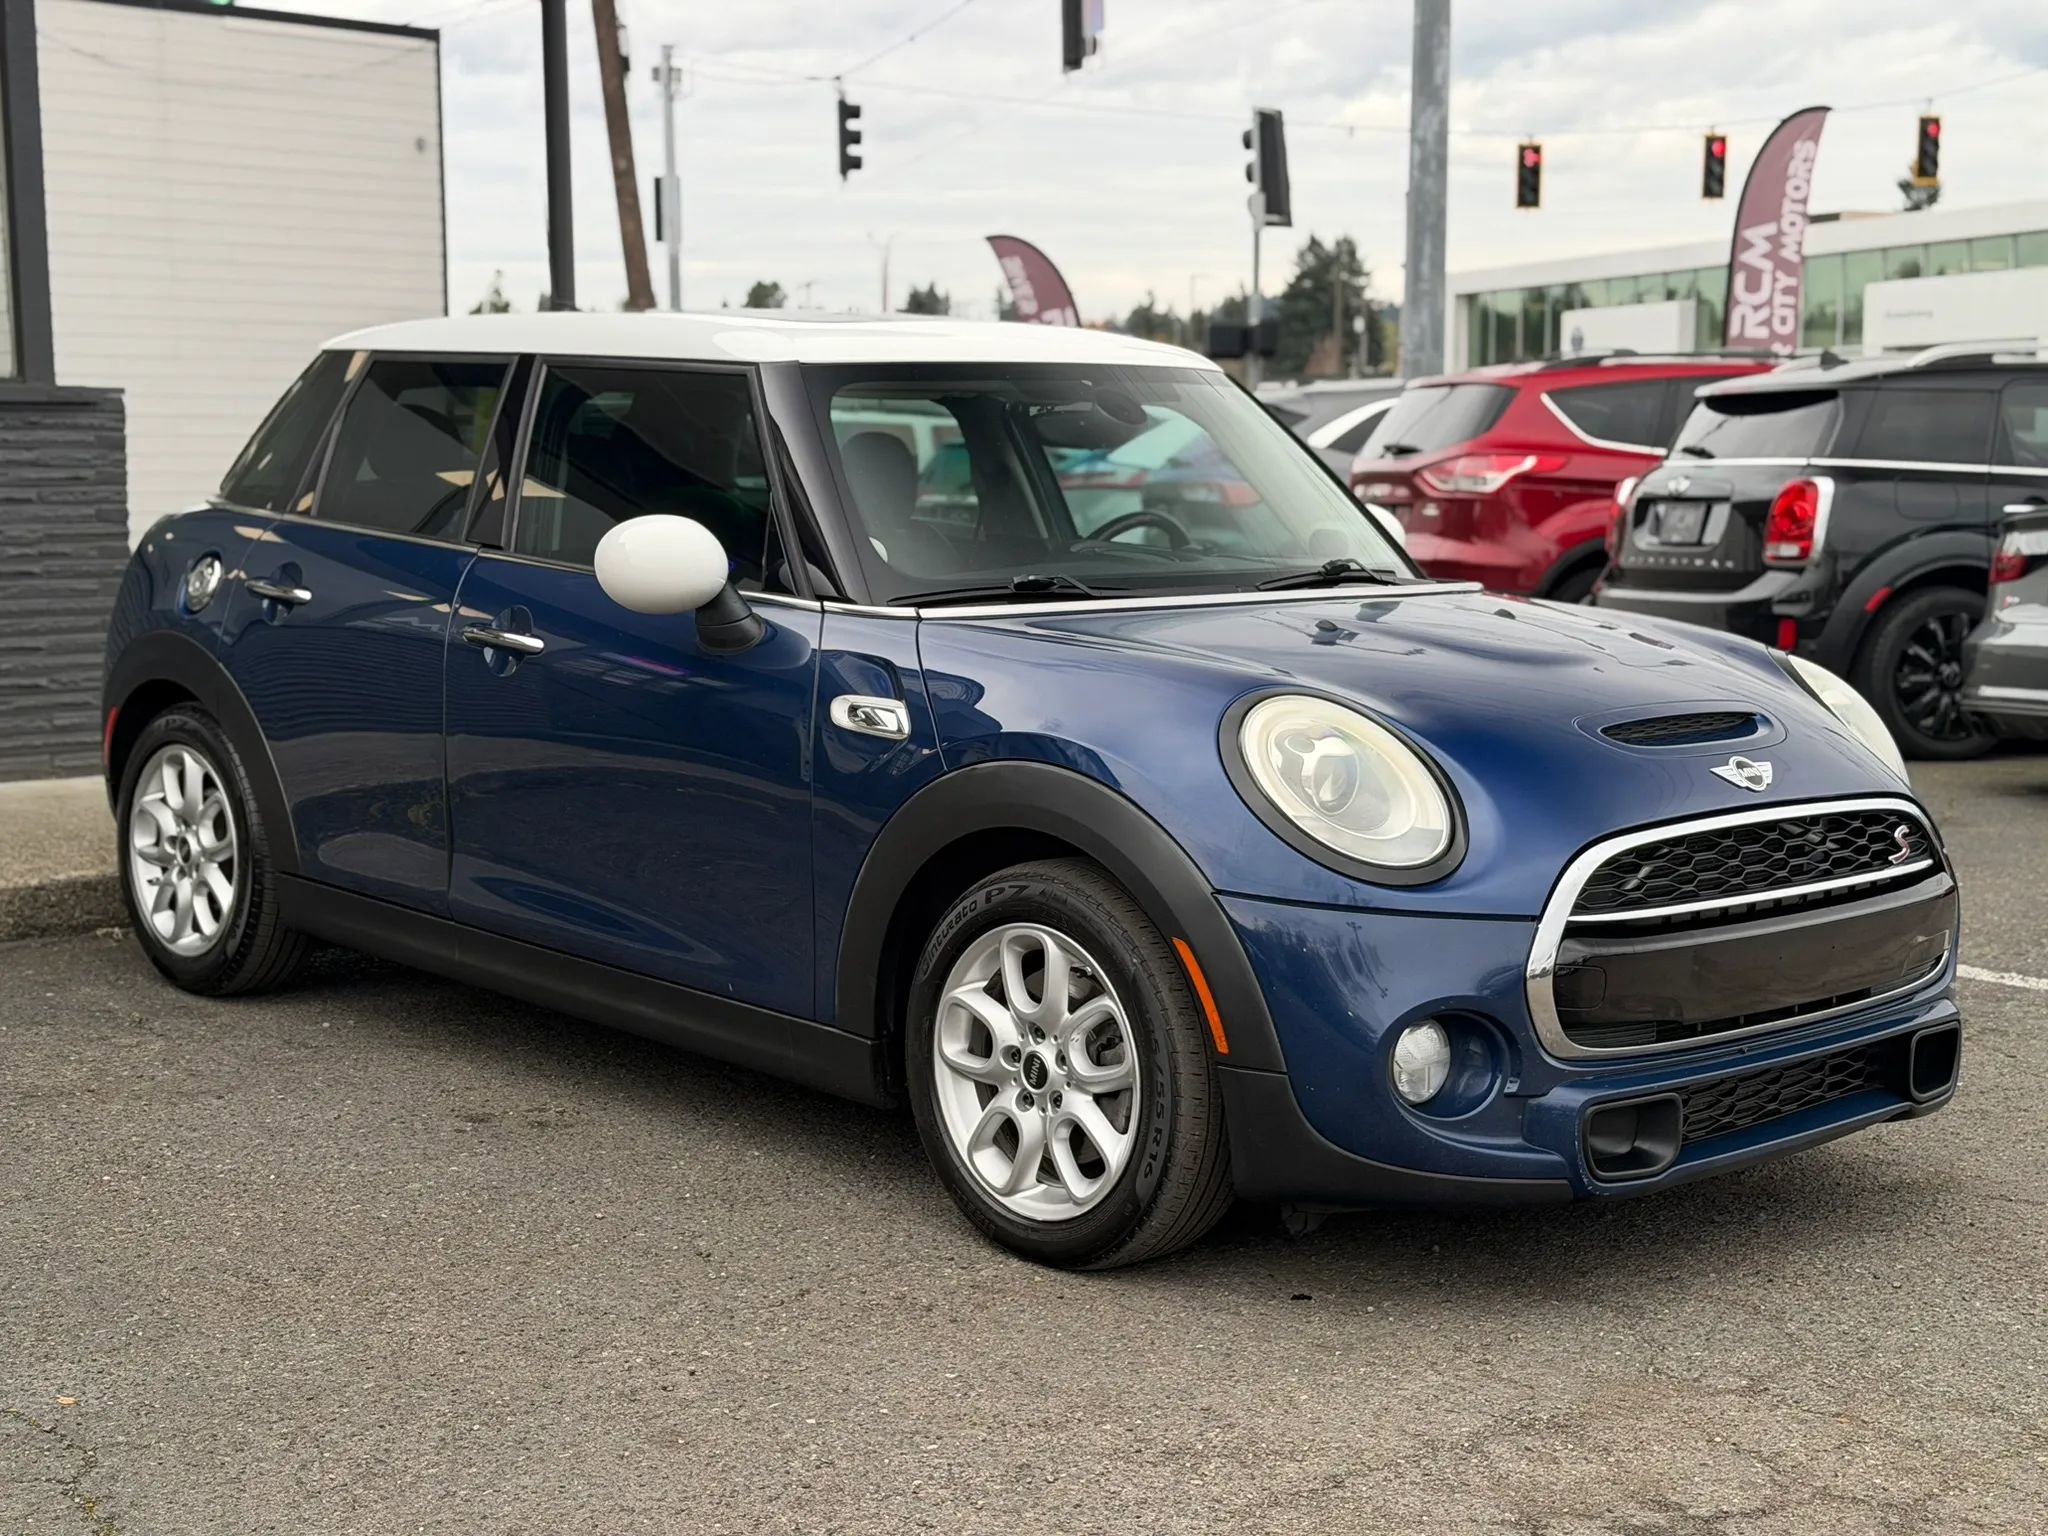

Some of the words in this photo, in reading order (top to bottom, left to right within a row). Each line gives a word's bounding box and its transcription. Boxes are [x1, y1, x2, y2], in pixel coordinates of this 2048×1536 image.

[1778, 139, 1818, 264] MOTORS
[1729, 222, 1779, 340] RCM
[1771, 269, 1799, 336] CITY
[1739, 767, 1762, 778] MINI
[1888, 825, 1910, 865] S
[984, 884, 1031, 905] P7
[1029, 1057, 1041, 1086] MINI
